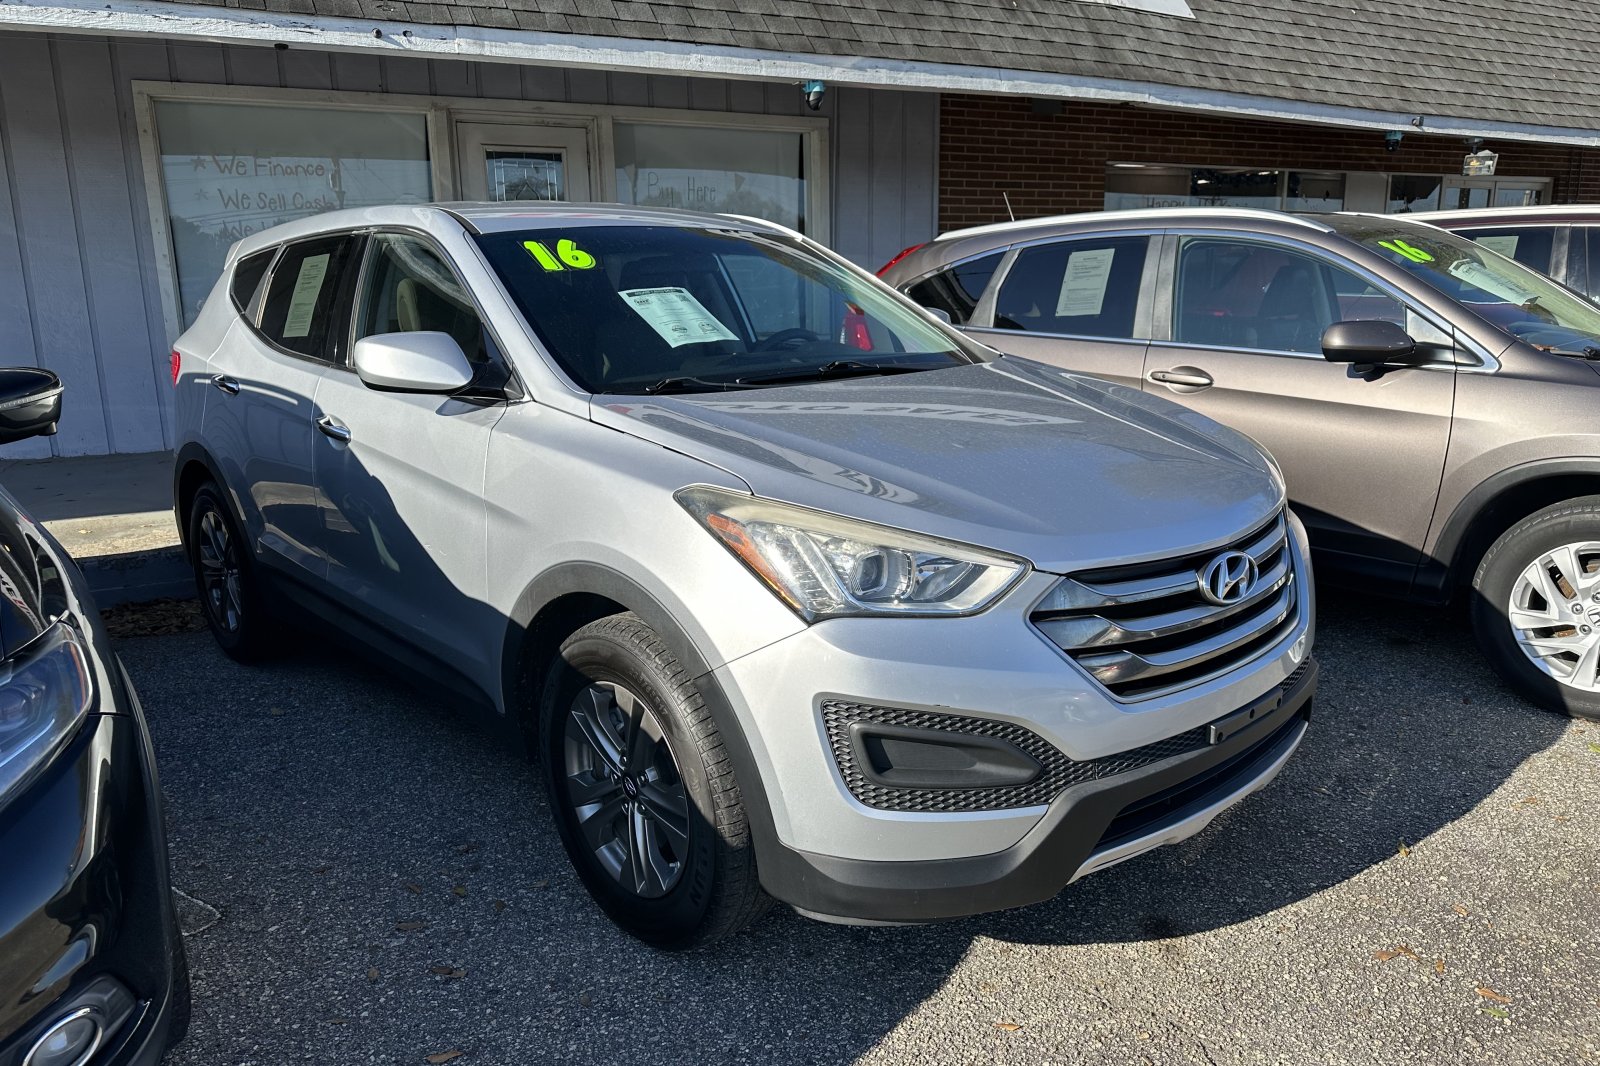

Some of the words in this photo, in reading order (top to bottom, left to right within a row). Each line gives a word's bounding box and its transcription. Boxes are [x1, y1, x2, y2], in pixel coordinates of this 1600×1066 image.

[211, 153, 247, 176] We
[254, 154, 325, 177] Finance
[217, 188, 251, 210] We
[257, 192, 287, 212] Sell
[292, 191, 336, 210] Cash
[687, 175, 716, 201] Here
[523, 239, 597, 271] 16
[1377, 239, 1436, 263] 16
